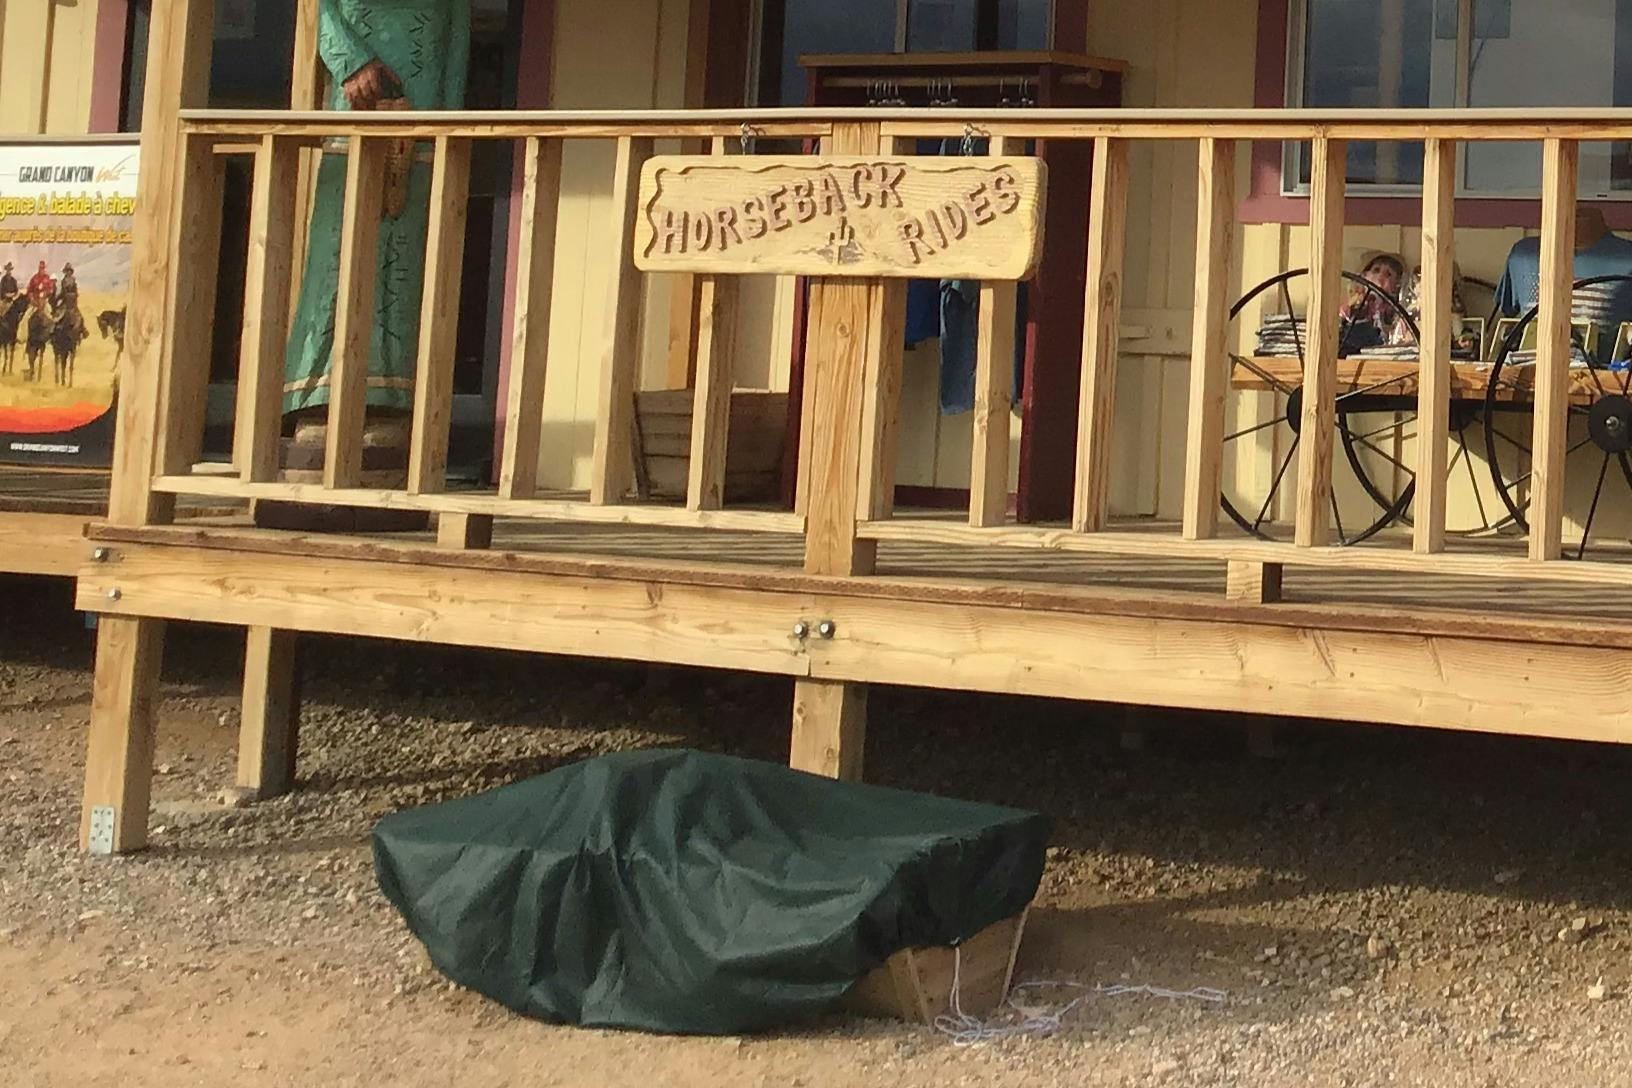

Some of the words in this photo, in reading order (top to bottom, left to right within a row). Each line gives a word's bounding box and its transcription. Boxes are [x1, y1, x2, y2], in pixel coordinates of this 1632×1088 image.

[19, 165, 53, 183] GRAND
[54, 165, 95, 183] CANYON
[657, 162, 907, 255] HORSEBACK
[897, 171, 1022, 264] RIDES
